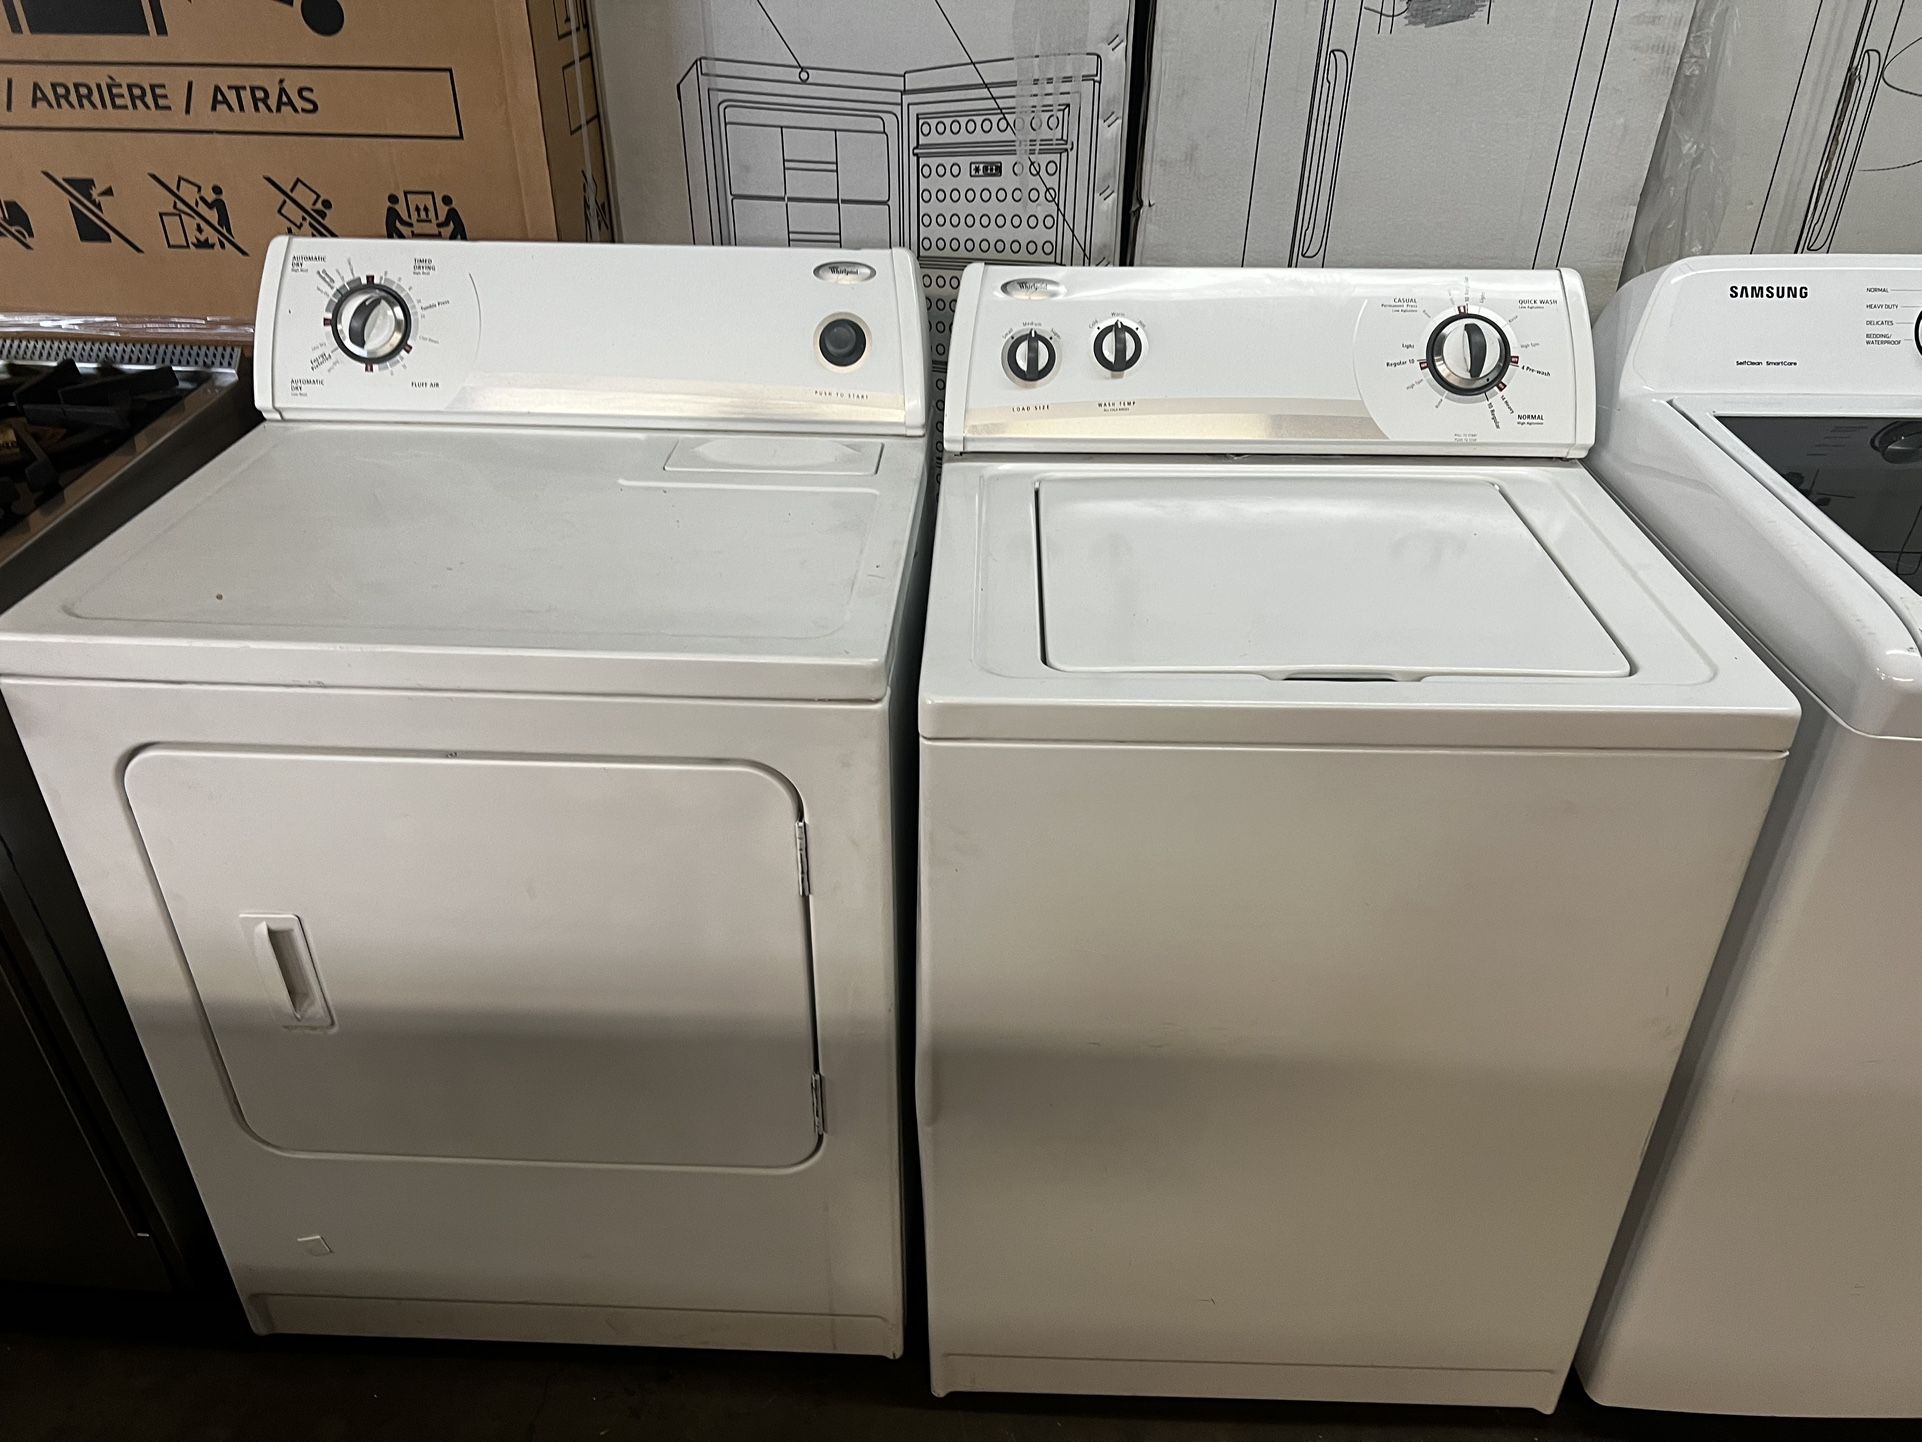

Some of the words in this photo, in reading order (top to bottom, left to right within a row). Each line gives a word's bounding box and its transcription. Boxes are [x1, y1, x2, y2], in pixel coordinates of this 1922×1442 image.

[31, 74, 172, 112] ARRIÈRE
[210, 78, 319, 114] ATRÁS
[292, 255, 327, 263] AUTOMATIC
[413, 257, 433, 265] TIMED
[828, 266, 859, 276] Whirlpool
[1729, 285, 1808, 299] SAMSUNG
[1386, 360, 1407, 368] Regular
[1526, 366, 1551, 377] Pre-wash
[290, 378, 325, 386] AUTOMATIC
[1490, 408, 1501, 430] Regular
